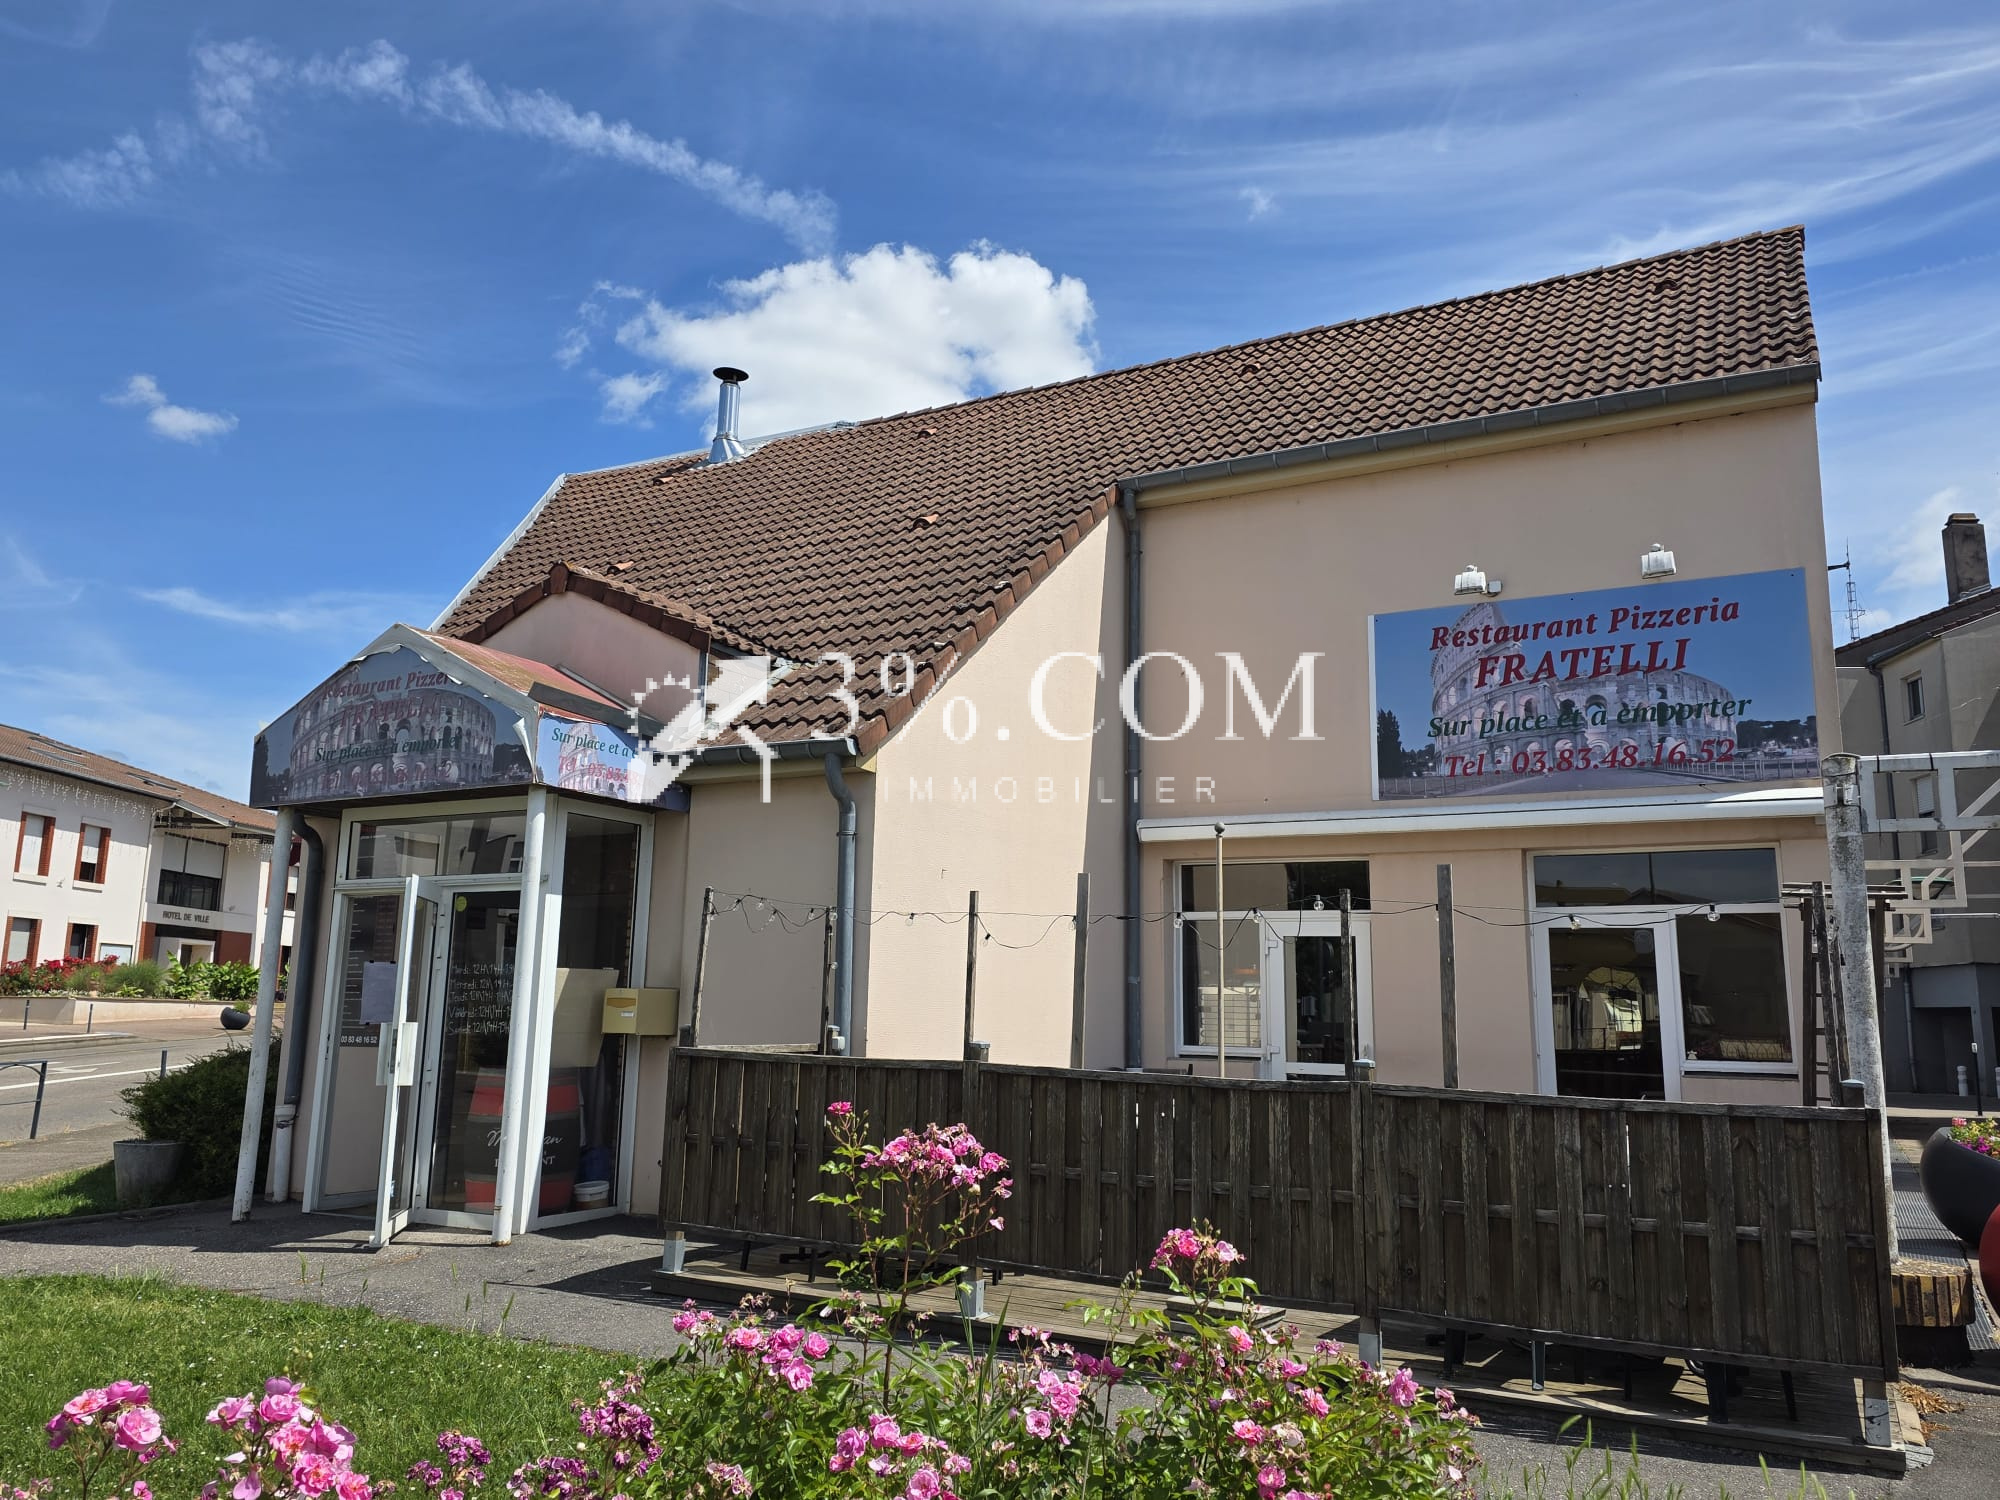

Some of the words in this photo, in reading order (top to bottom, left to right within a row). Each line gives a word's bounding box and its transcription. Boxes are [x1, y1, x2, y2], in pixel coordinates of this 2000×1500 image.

[1429, 613, 1598, 650] Restaurant
[1607, 597, 1740, 634] Pizzeria
[1474, 638, 1692, 689] FRATELLI
[323, 676, 402, 700] Restaurant
[1427, 715, 1472, 738] Sur
[1479, 711, 1548, 739] place
[1556, 706, 1583, 728] et
[1617, 698, 1752, 727] emporter
[315, 746, 336, 762] Sur
[338, 743, 371, 764] place
[552, 727, 572, 744] Sur
[575, 734, 606, 752] place
[608, 744, 621, 756] et
[1444, 753, 1485, 778] Tel
[1511, 738, 1735, 776] 03.83.48.16.52
